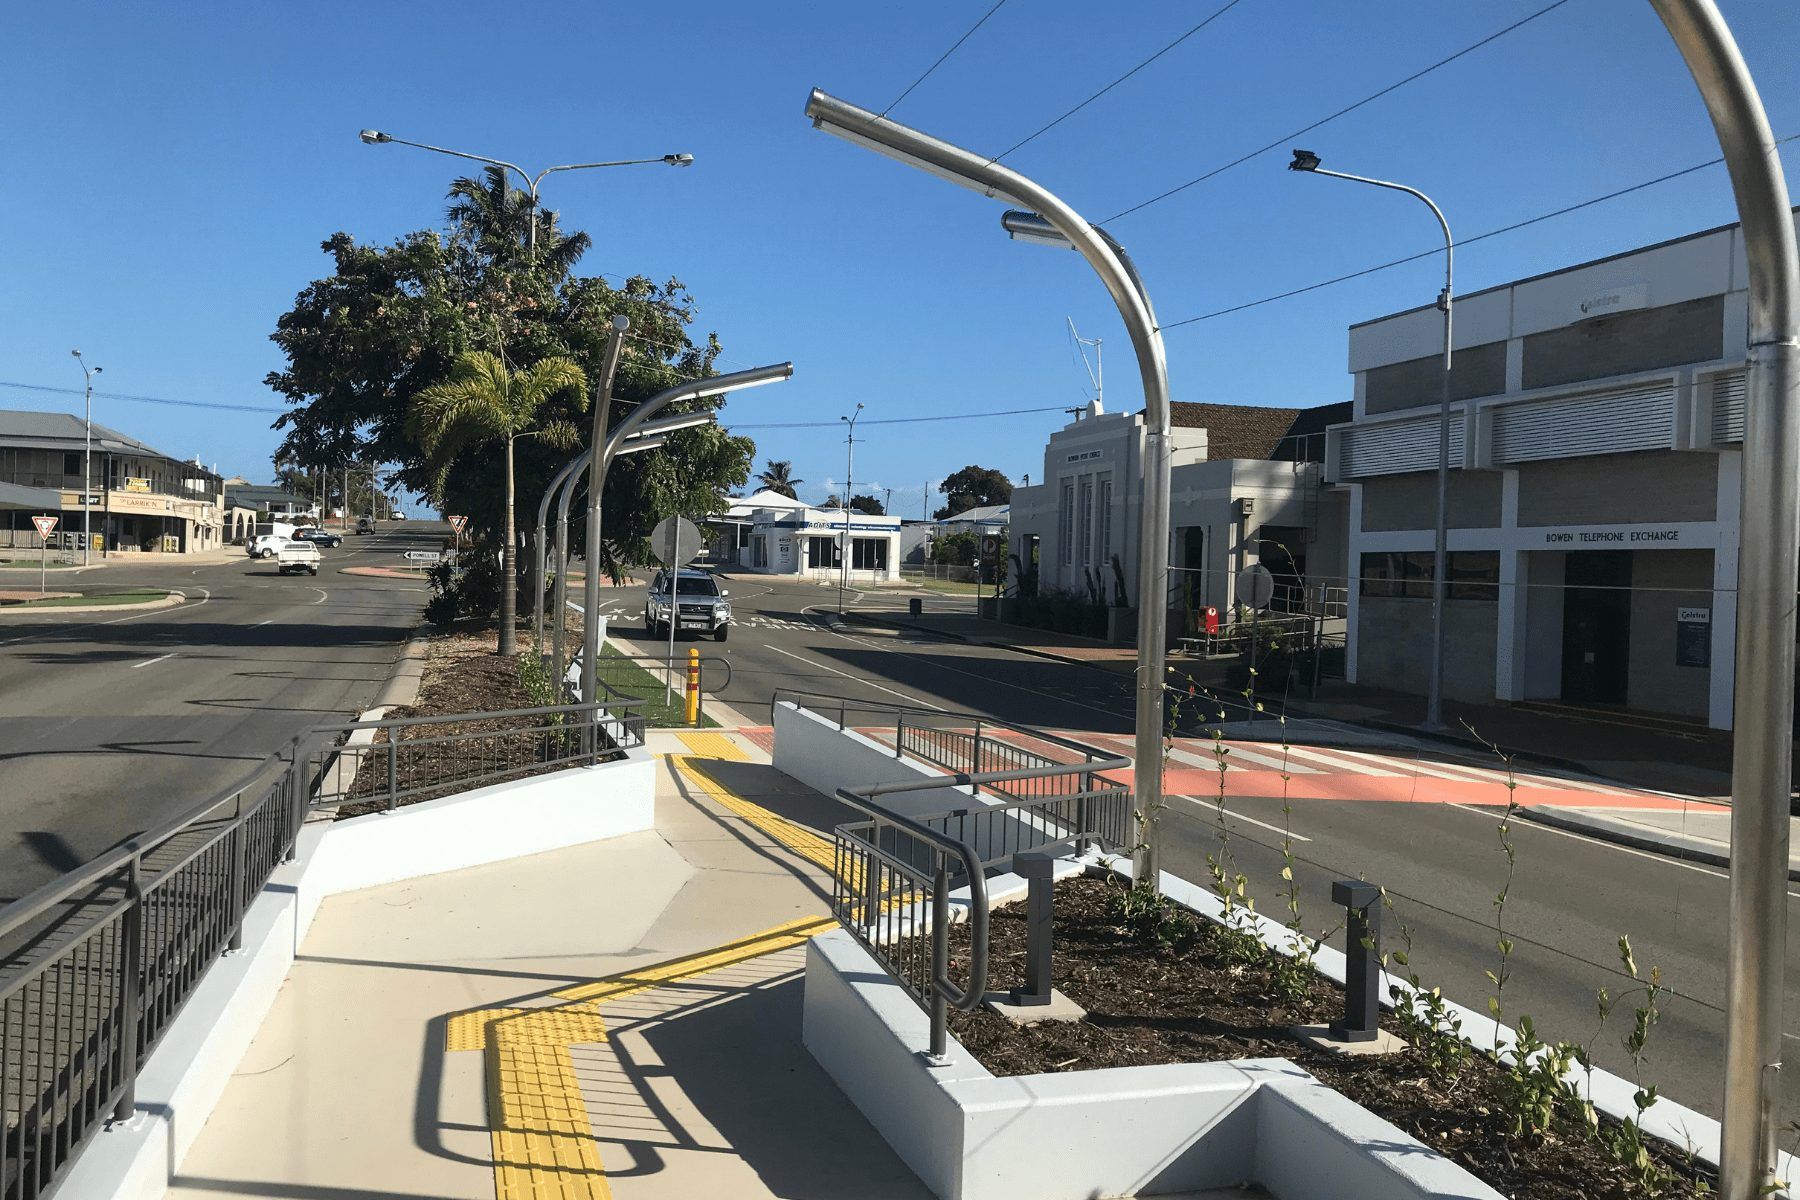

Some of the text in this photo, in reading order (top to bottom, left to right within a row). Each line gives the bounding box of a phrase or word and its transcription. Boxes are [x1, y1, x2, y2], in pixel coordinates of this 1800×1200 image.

[1546, 530, 1679, 542] BOWEN TELEPHONE EXCHANGE
[1681, 611, 1706, 619] Telstra
